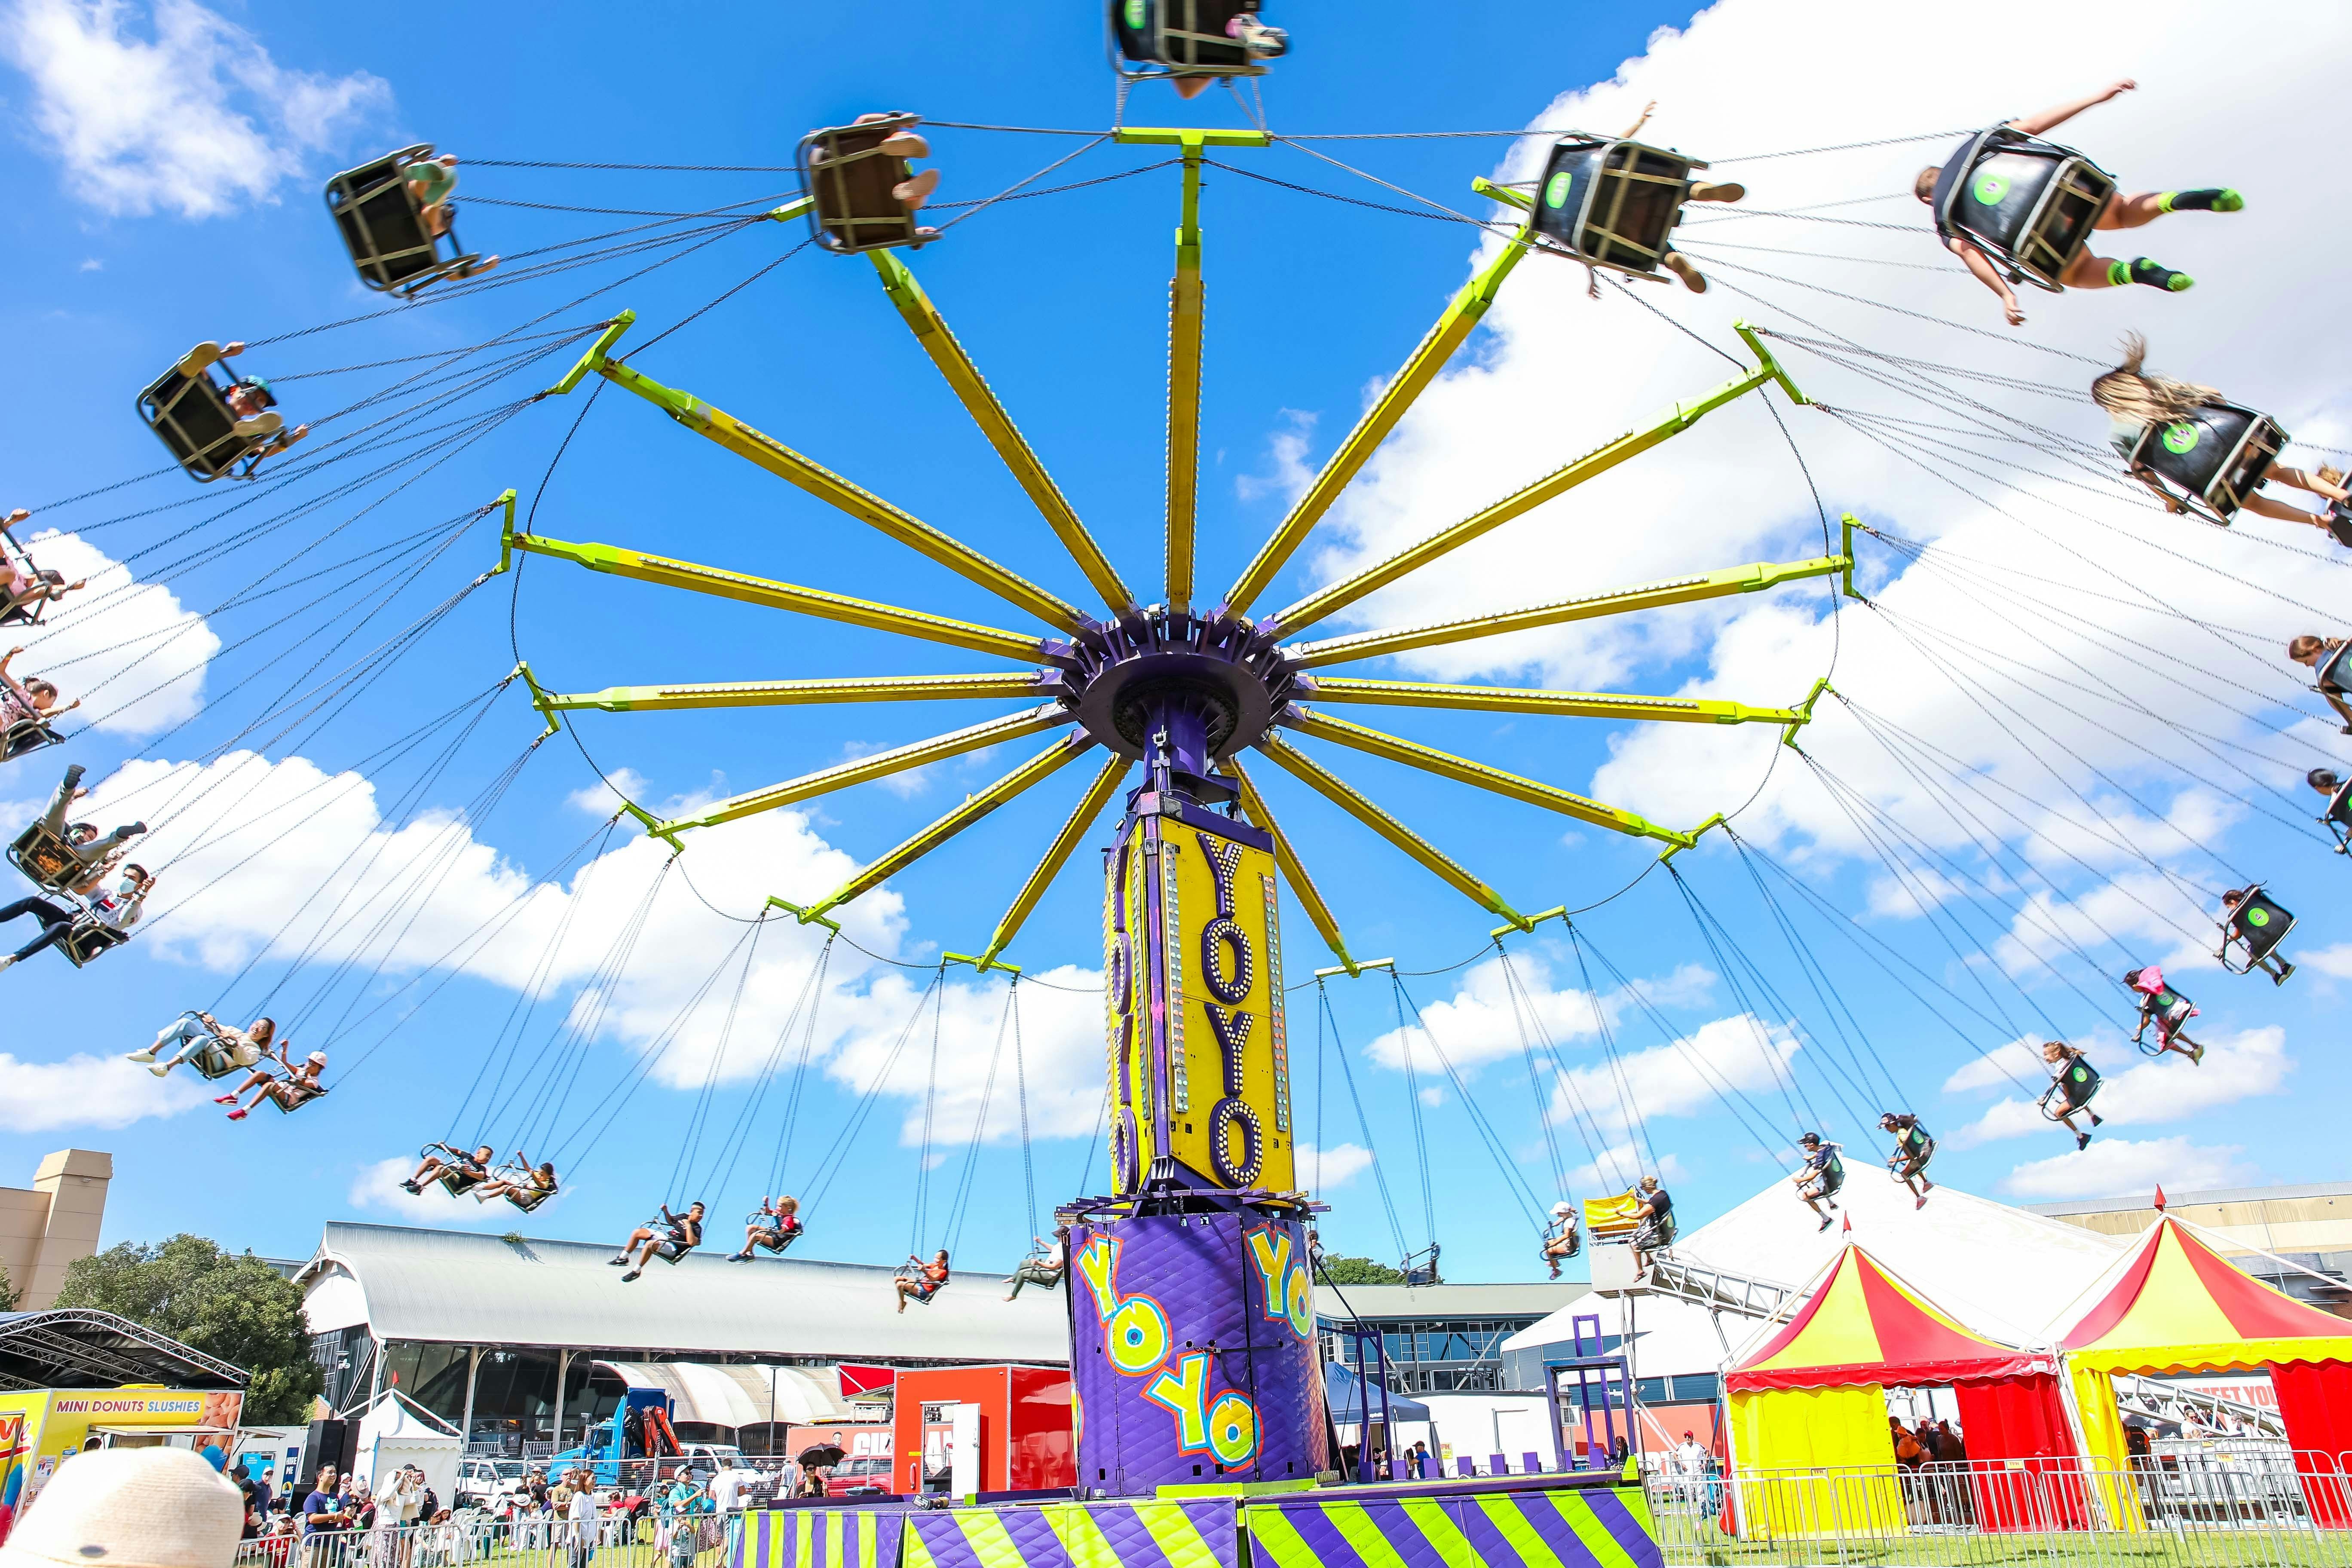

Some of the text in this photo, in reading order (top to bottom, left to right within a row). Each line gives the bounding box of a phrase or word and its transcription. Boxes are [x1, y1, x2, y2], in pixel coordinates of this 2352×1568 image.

[1196, 832, 1262, 1188] YOYO
[56, 1401, 200, 1412] MINI DONUTS SLUSHIES
[286, 1457, 297, 1465] HIRE
[285, 1466, 294, 1475] ME
